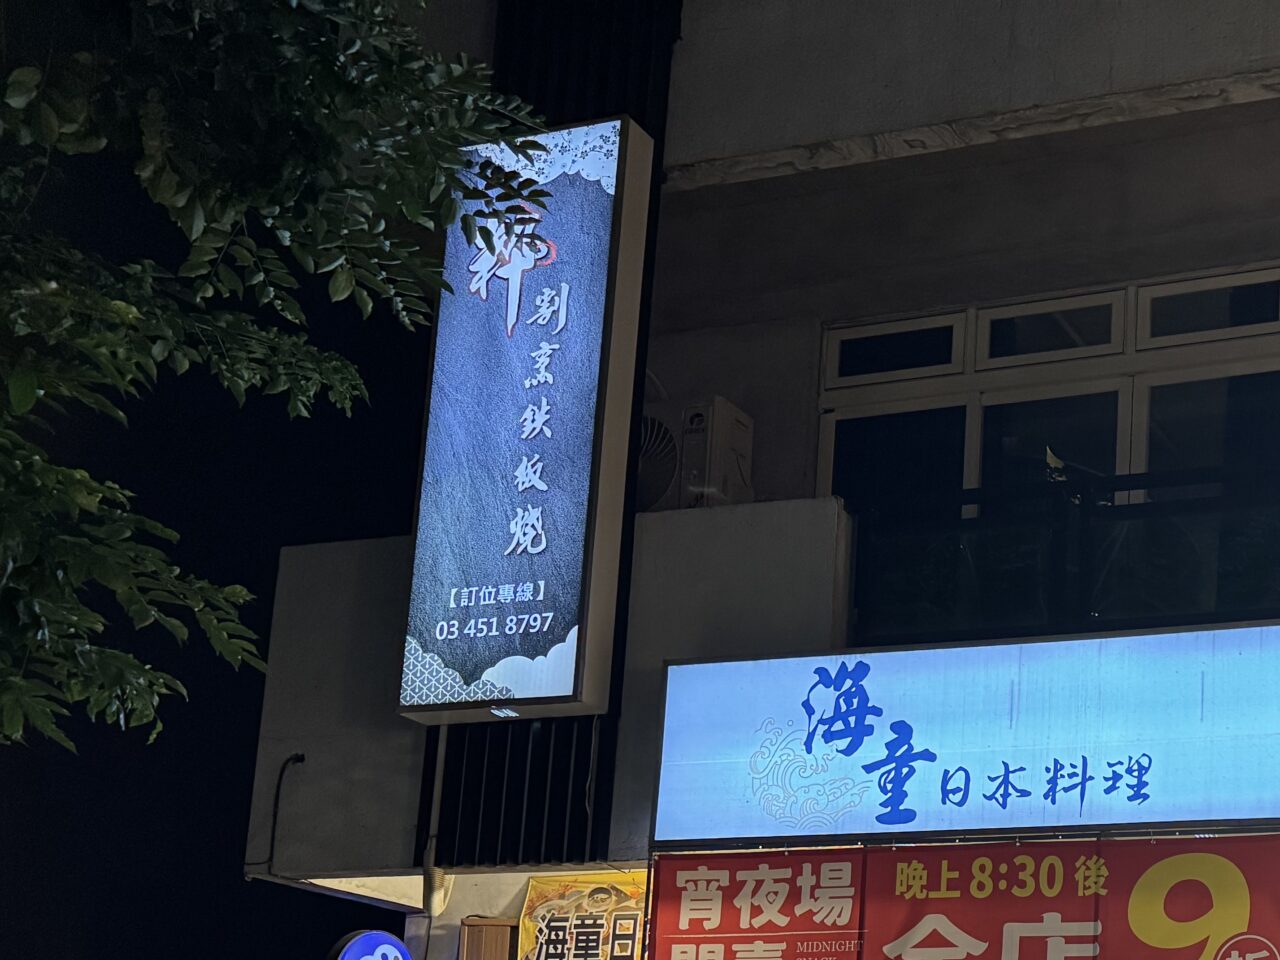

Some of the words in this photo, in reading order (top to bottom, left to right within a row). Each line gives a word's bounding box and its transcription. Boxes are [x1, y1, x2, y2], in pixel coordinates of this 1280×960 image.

[435, 620, 459, 640] 03
[463, 616, 500, 638] 451
[504, 612, 554, 635] 8797
[801, 660, 938, 826] 海童
[939, 752, 1154, 818] 日本料理
[675, 861, 856, 931] 宵夜場
[894, 859, 962, 901] 晚上
[970, 854, 1064, 898] 8:30
[1074, 854, 1110, 898] 後
[796, 939, 865, 954] MIDNIGHT
